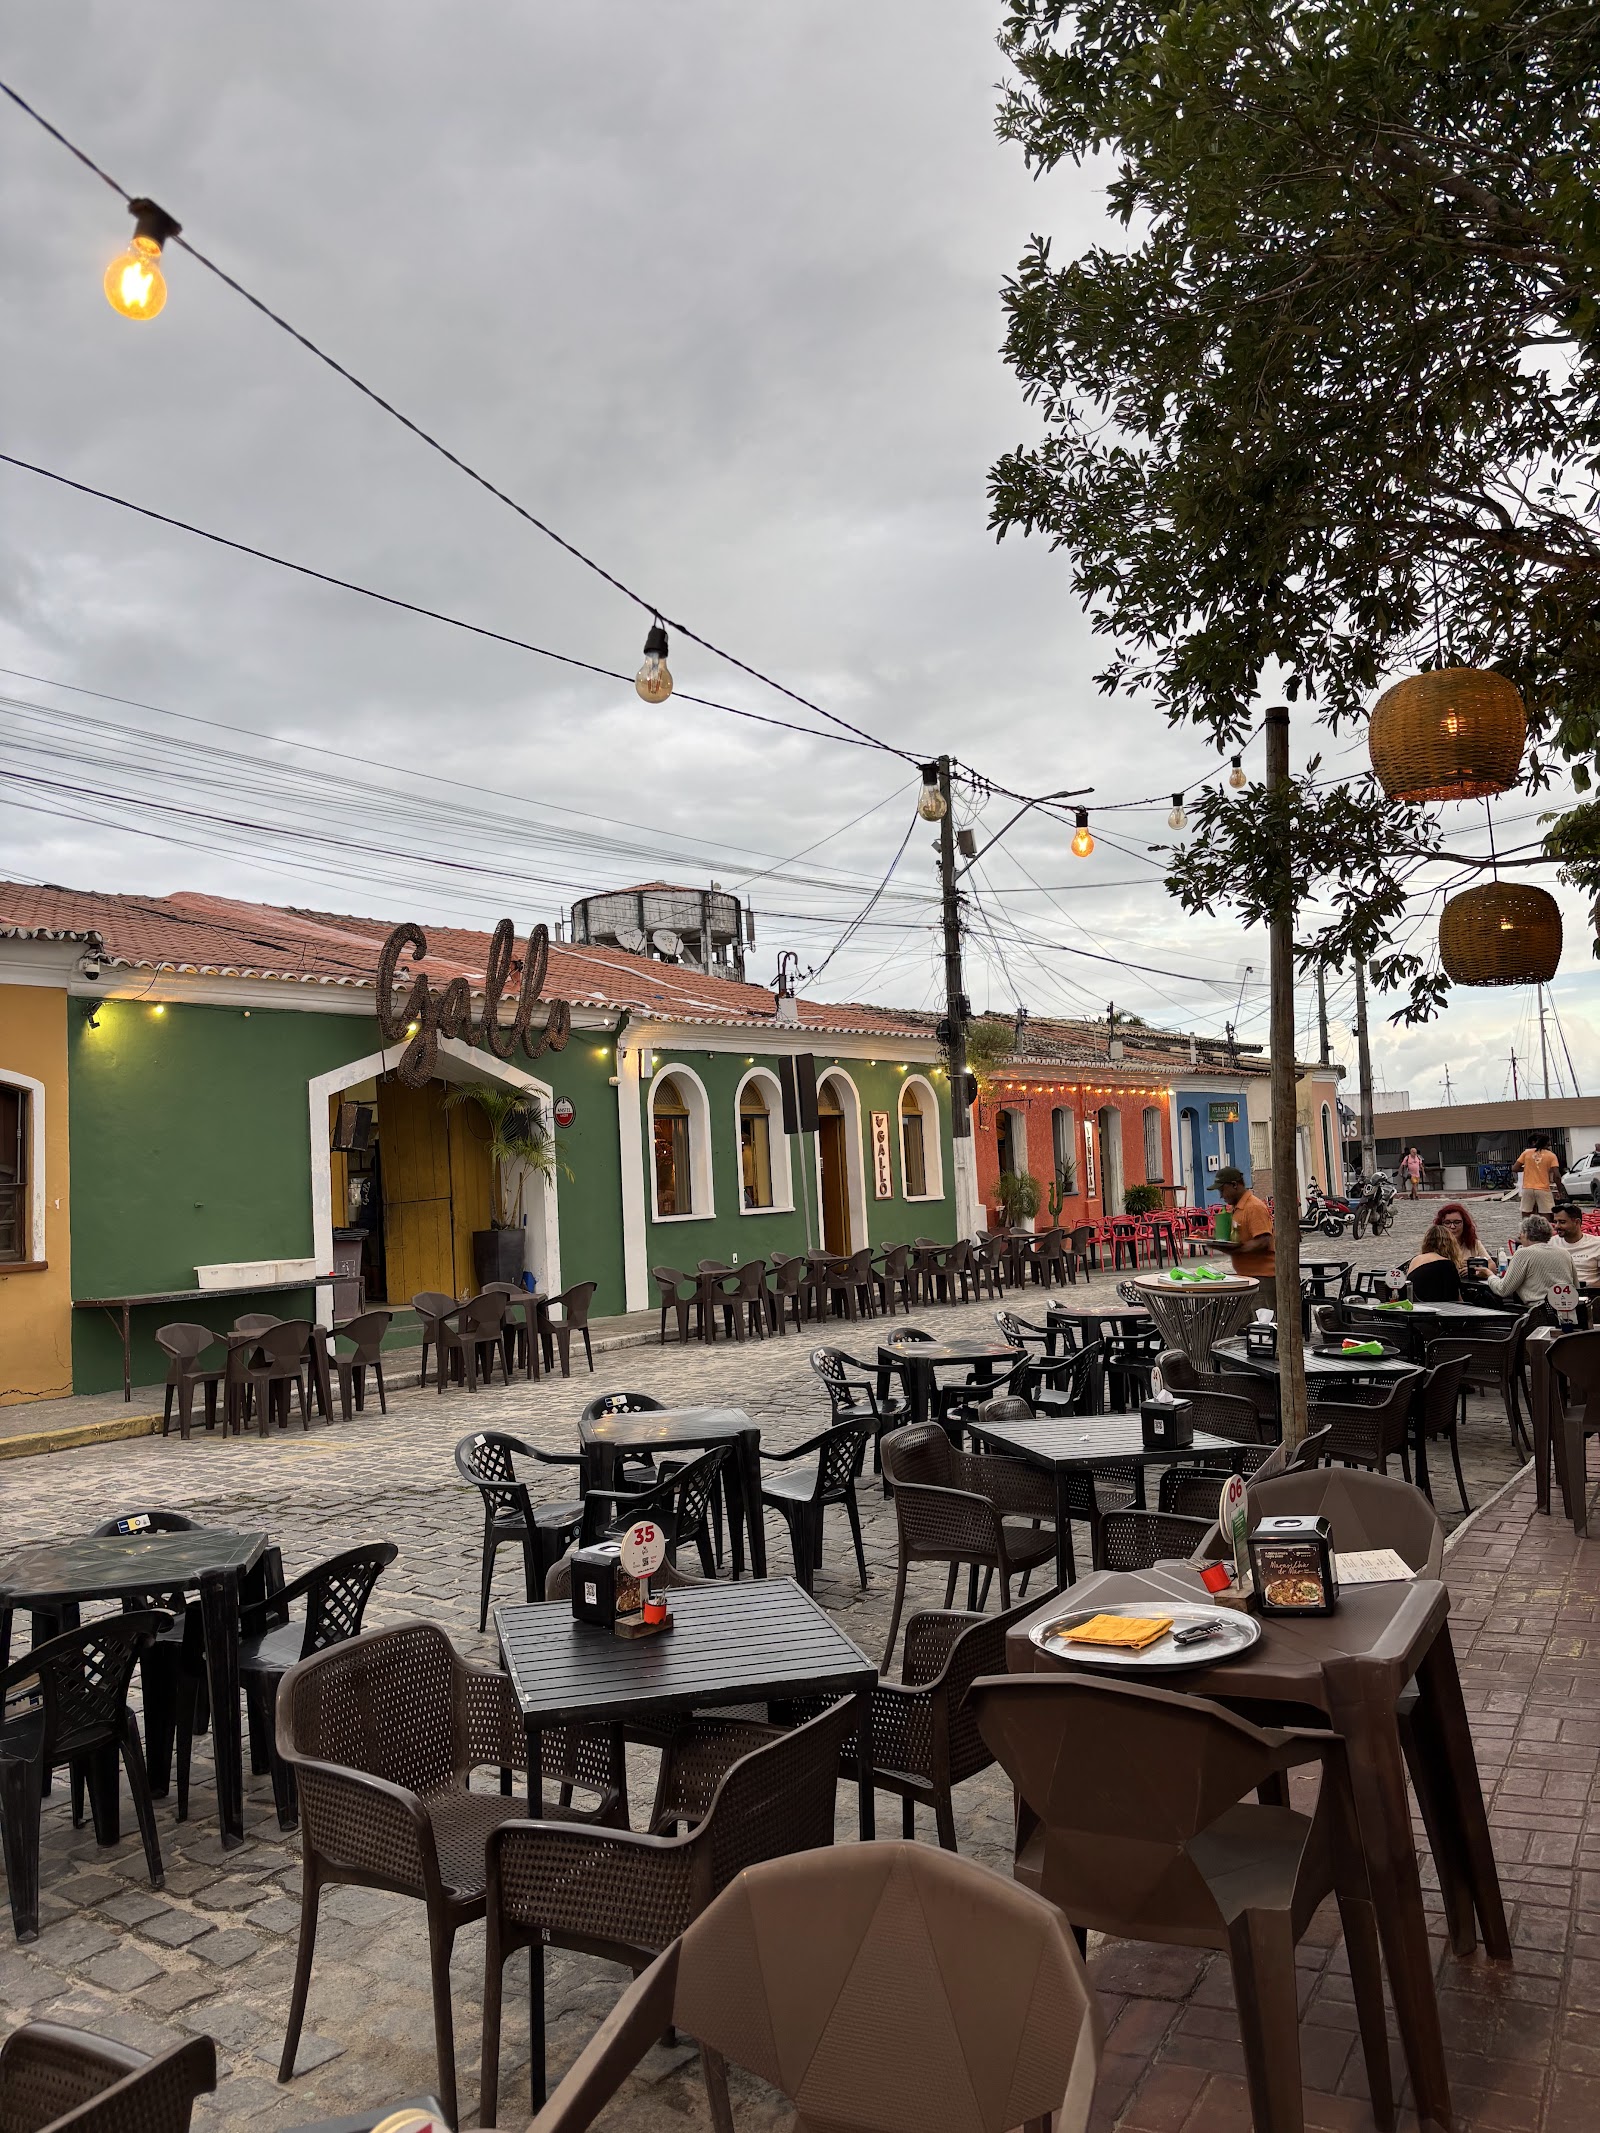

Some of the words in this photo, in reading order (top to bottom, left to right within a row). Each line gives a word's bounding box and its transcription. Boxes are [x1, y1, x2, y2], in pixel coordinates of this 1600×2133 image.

[376, 918, 570, 1089] Gallo
[876, 1130, 888, 1196] GALLO
[1390, 1270, 1401, 1278] 32
[1553, 1285, 1571, 1295] 04
[1229, 1478, 1242, 1503] 06
[634, 1525, 655, 1546] 35
